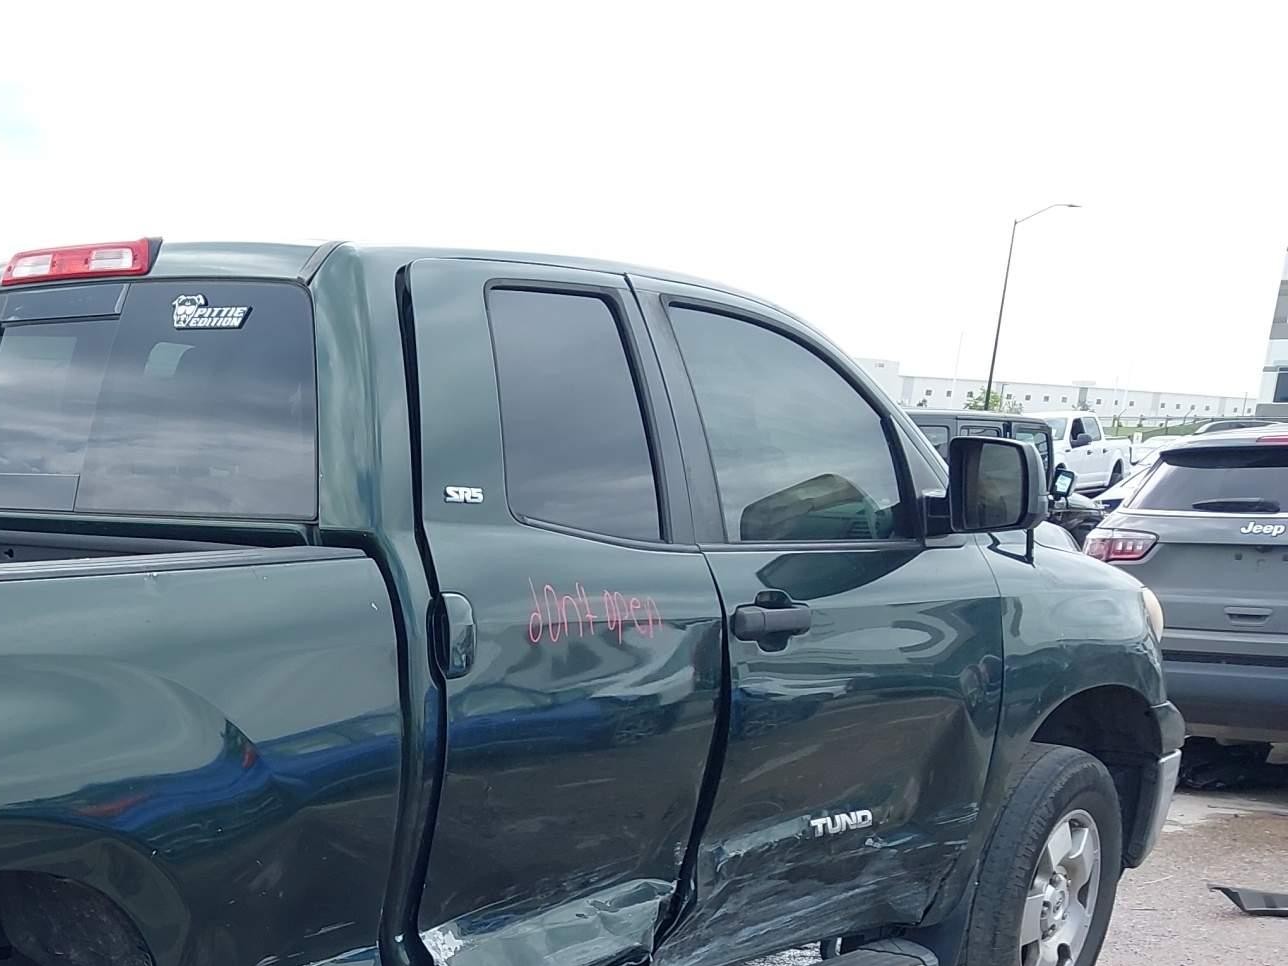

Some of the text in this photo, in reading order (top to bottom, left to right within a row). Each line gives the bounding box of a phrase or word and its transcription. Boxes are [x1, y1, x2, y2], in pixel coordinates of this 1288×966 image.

[193, 306, 249, 318] PITTIE
[189, 317, 243, 328] EDITION
[444, 485, 485, 504] SR5
[1240, 520, 1286, 537] Jeep
[604, 588, 664, 645] open
[810, 809, 873, 838] TUND
